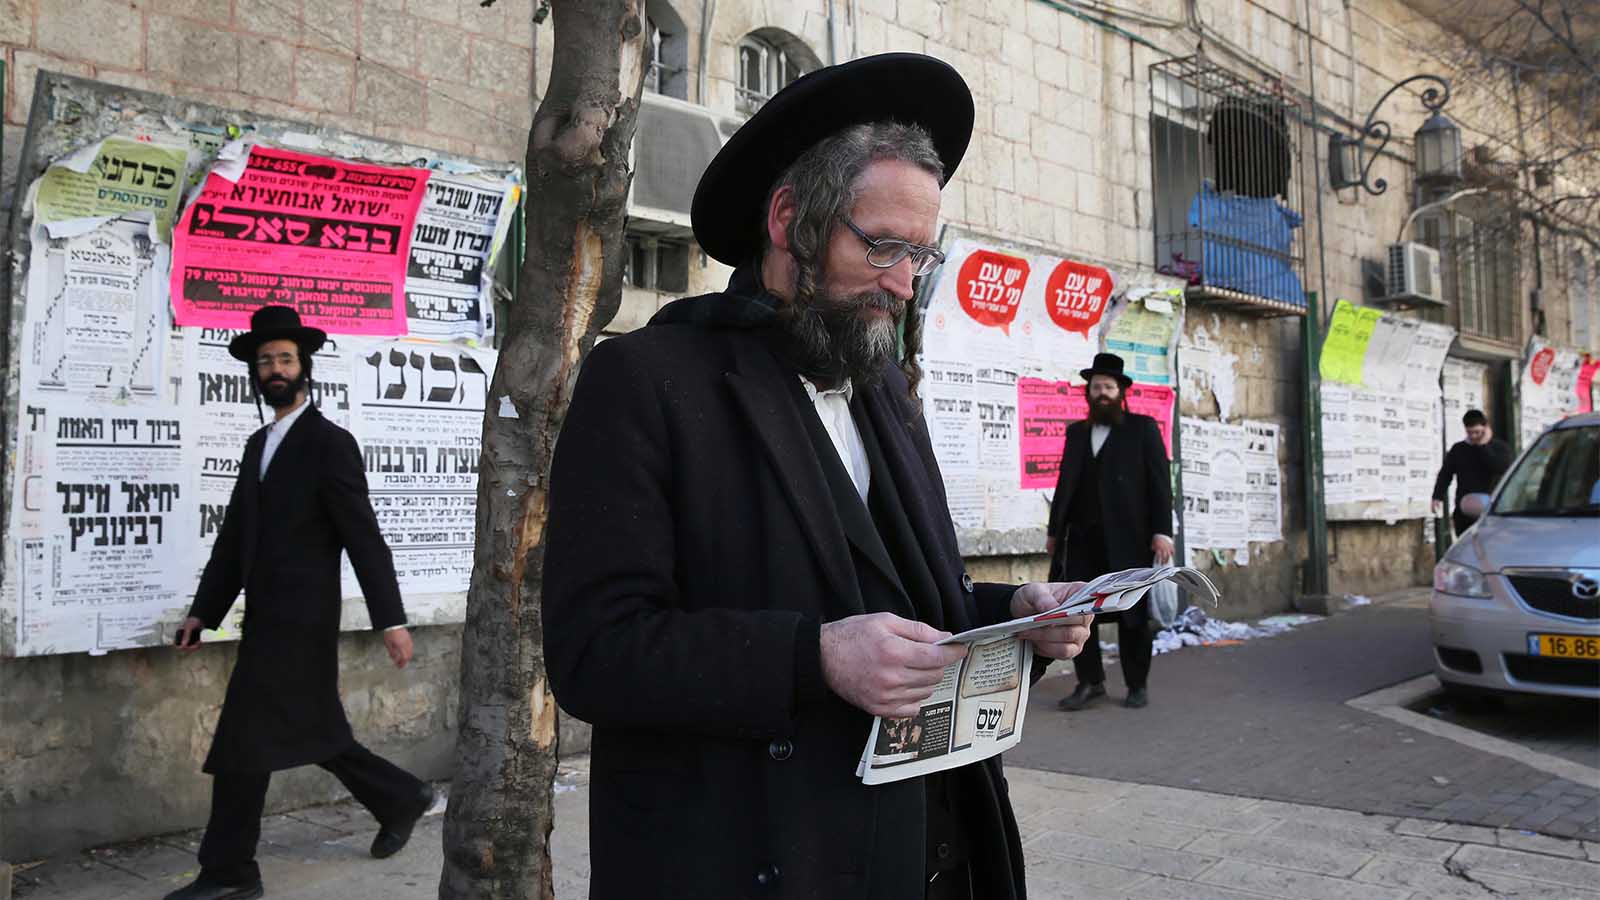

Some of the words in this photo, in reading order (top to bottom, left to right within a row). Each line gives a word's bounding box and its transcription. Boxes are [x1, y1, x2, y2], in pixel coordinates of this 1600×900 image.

[230, 184, 325, 211] אבוחצירא
[331, 193, 391, 217] ישראל
[196, 206, 312, 244] סאלי
[320, 223, 392, 253] בבא
[185, 268, 201, 280] 79
[203, 270, 238, 283] הנביא
[240, 272, 279, 286] שמואל
[978, 262, 1003, 283] עם
[1004, 268, 1022, 285] יש
[1064, 272, 1086, 290] עם
[274, 287, 293, 300] ליד
[341, 281, 393, 294] אוטובוסים
[967, 279, 1004, 303] לדבר
[1086, 276, 1103, 294] יש
[1005, 287, 1022, 306] מי
[1055, 286, 1086, 310] לדבר
[1087, 294, 1101, 313] מי
[318, 303, 357, 318] יחזקאל
[57, 417, 104, 440] האמת
[111, 418, 138, 443] דיין
[145, 419, 181, 443] ברוך
[363, 445, 428, 473] הרבבות
[436, 446, 480, 474] עצרת
[384, 474, 417, 484] השבת
[419, 474, 441, 484] ככר
[442, 475, 456, 484] פני
[56, 481, 111, 514] מיכל
[121, 481, 180, 513] יחיאל
[69, 515, 163, 552] רבינוביץ
[1548, 637, 1568, 655] 16
